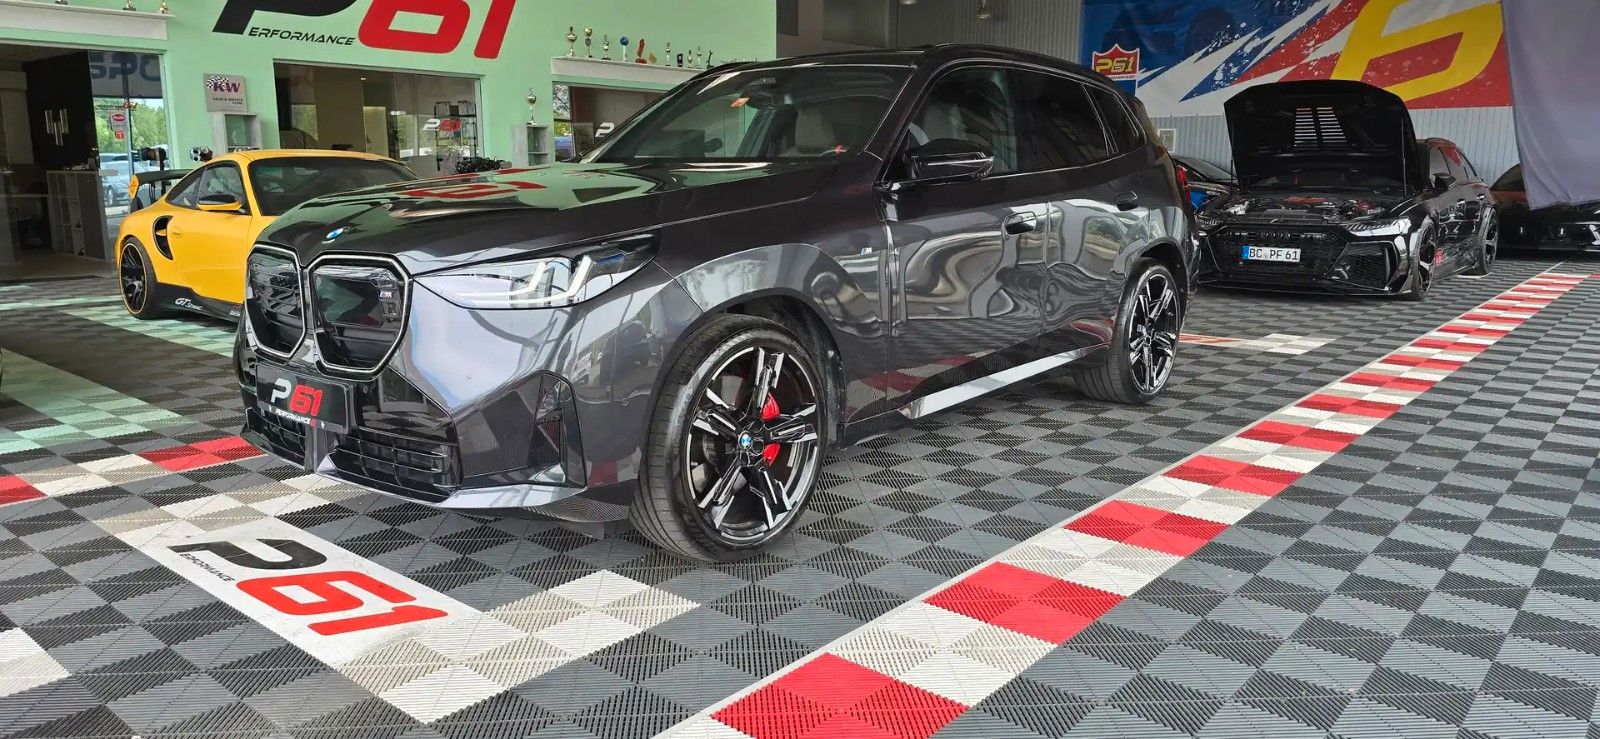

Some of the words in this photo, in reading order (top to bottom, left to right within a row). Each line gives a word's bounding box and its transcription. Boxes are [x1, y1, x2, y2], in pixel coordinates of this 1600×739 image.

[1095, 56, 1135, 73] P61
[1249, 248, 1263, 259] BC
[1269, 249, 1284, 260] PF
[1285, 250, 1299, 261] 61
[271, 377, 323, 417] P61
[166, 538, 449, 636] P61
